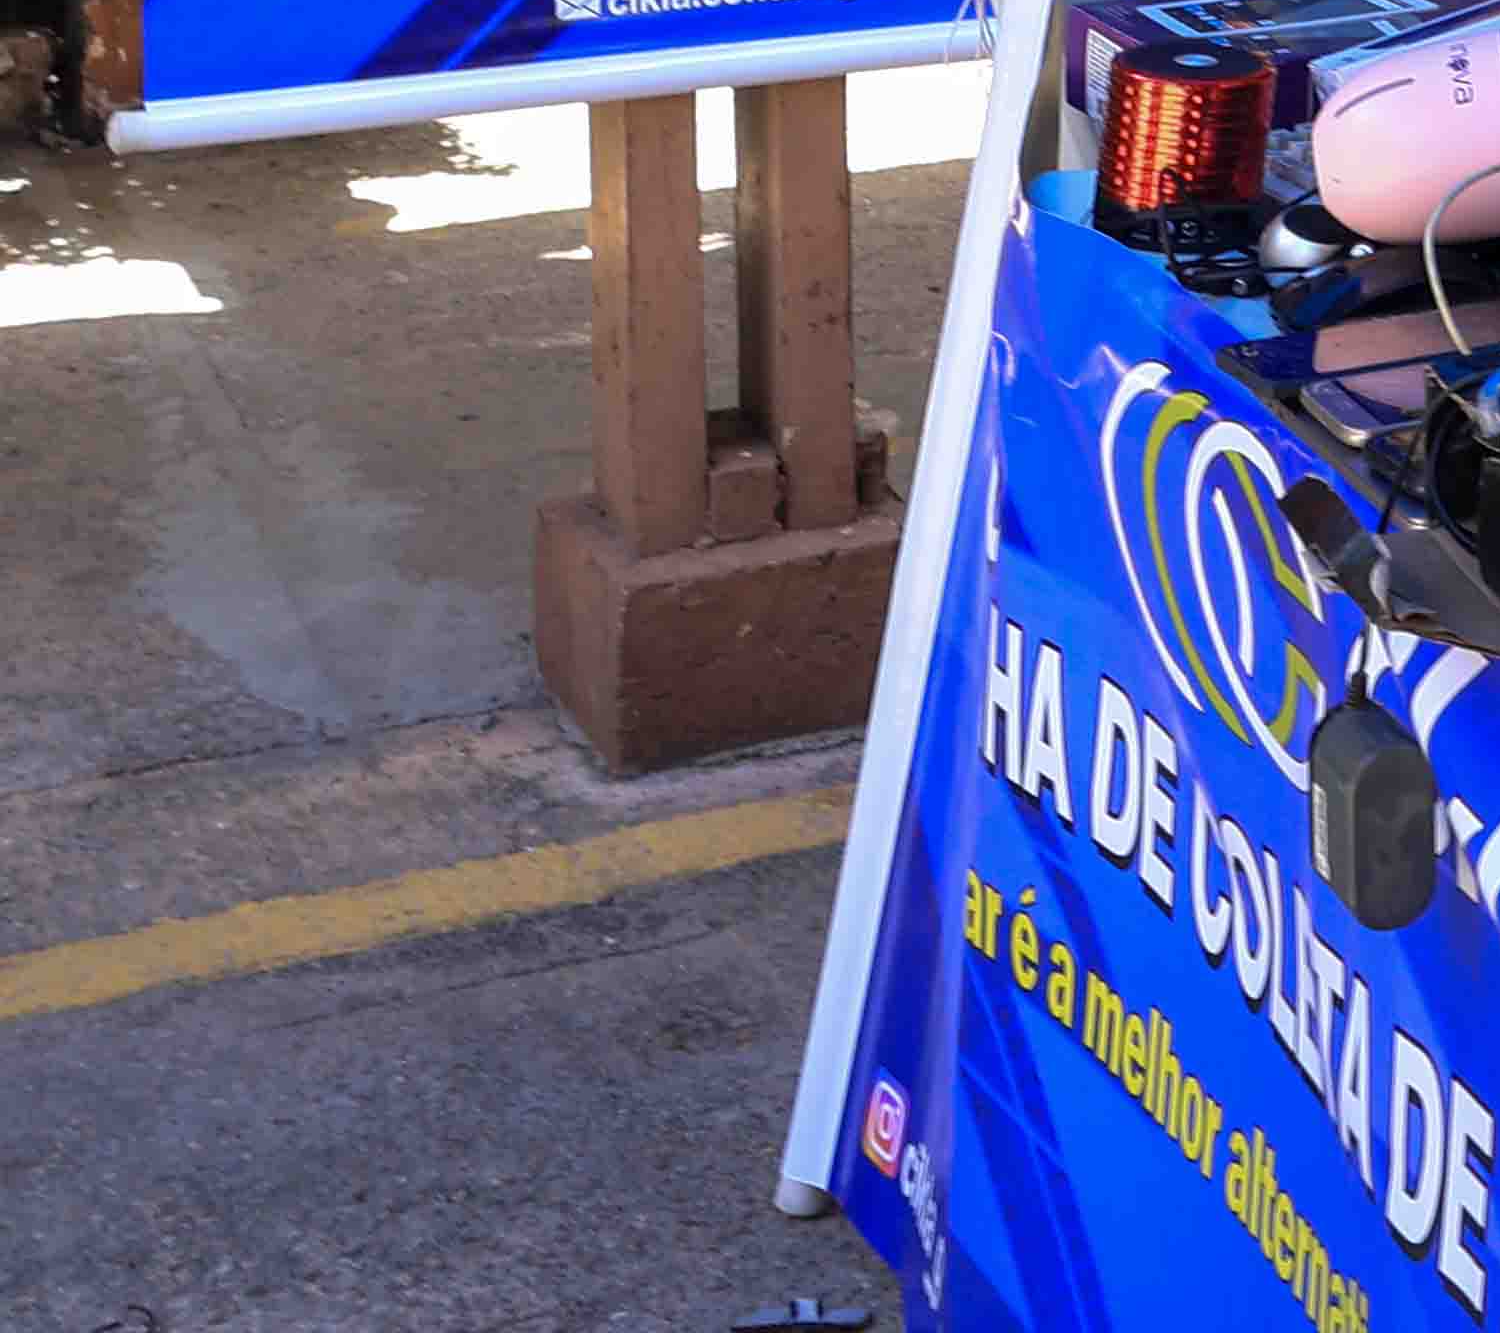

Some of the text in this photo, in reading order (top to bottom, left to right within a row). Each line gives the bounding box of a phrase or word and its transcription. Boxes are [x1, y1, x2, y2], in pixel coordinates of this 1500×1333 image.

[1010, 885, 1040, 992] é
[1046, 941, 1076, 1029] a
[1082, 970, 1223, 1181] melhor
[1088, 671, 1179, 918] DE
[1190, 778, 1376, 1203] COLETA
[1384, 1025, 1495, 1328] DE
